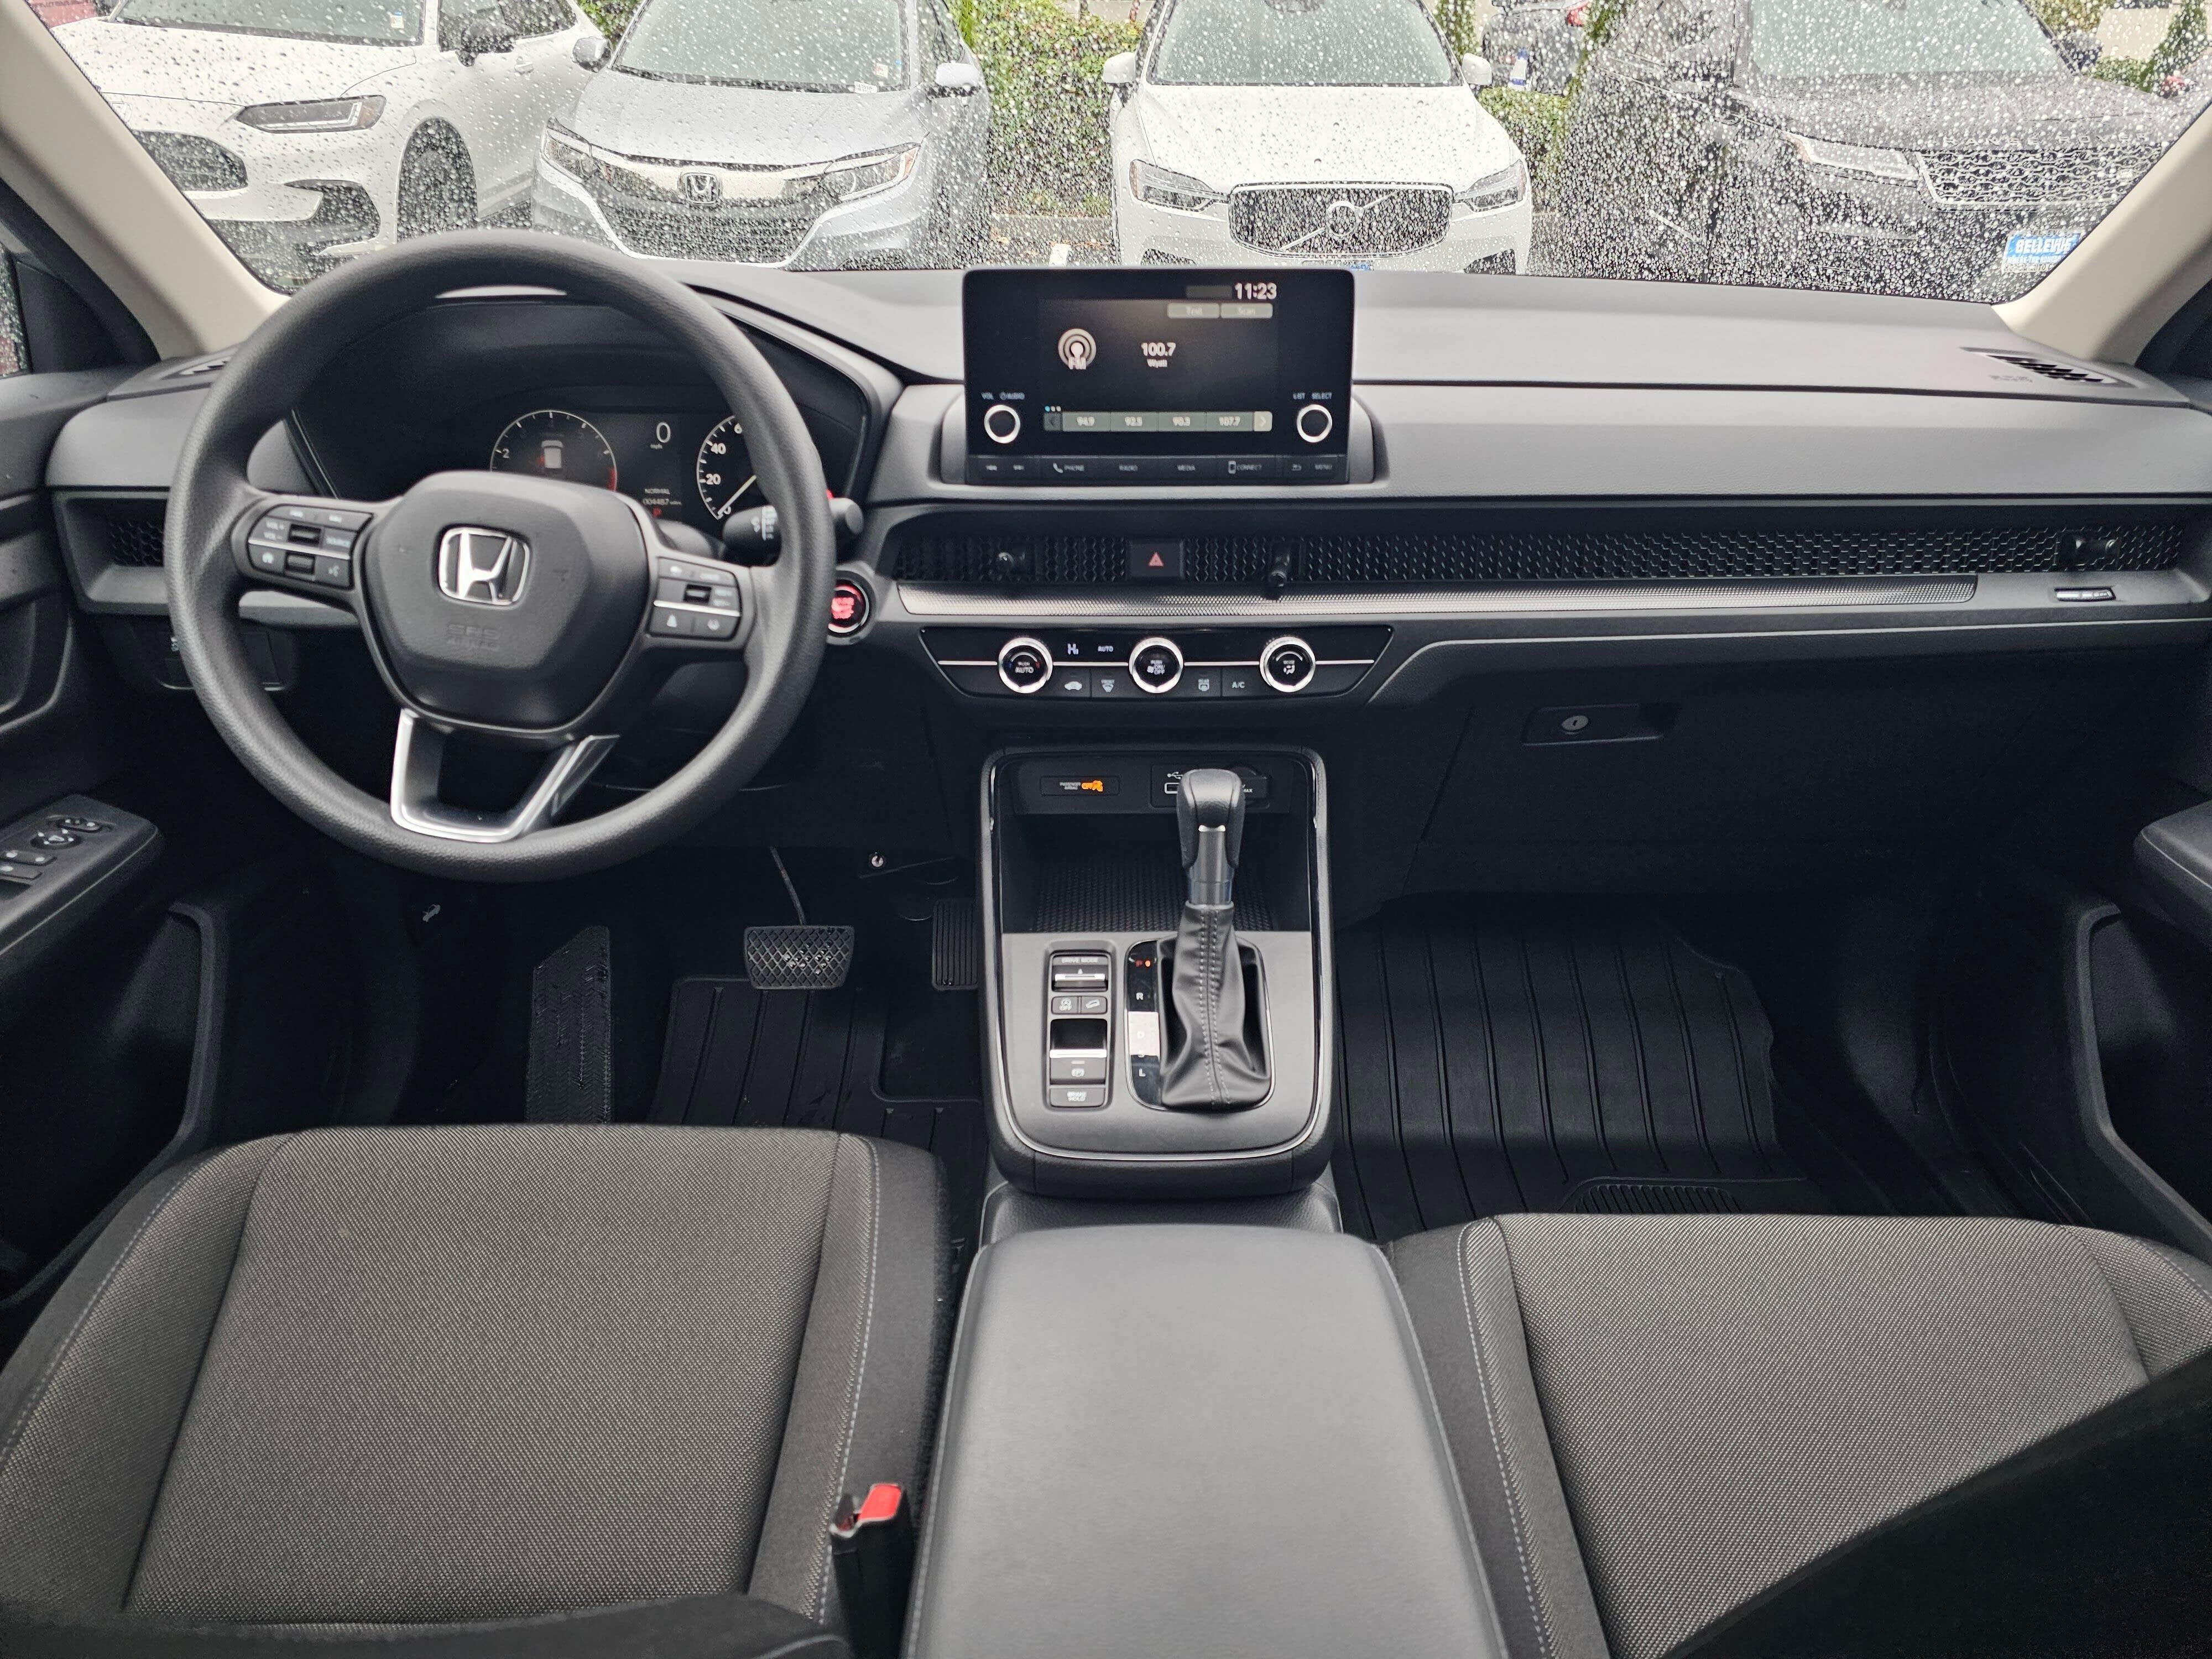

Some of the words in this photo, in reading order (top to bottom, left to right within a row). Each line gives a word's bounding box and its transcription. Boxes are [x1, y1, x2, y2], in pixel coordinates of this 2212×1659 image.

[2015, 238, 2075, 255] BELLEVUE
[1235, 283, 1277, 299] 11:23
[1141, 342, 1176, 357] 100.7
[1068, 357, 1087, 369] FM
[656, 422, 671, 444] 0
[503, 448, 510, 458] 2
[711, 442, 727, 455] 40
[706, 473, 721, 485] 20
[1136, 992, 1144, 1000] R
[1139, 1068, 1146, 1077] L
